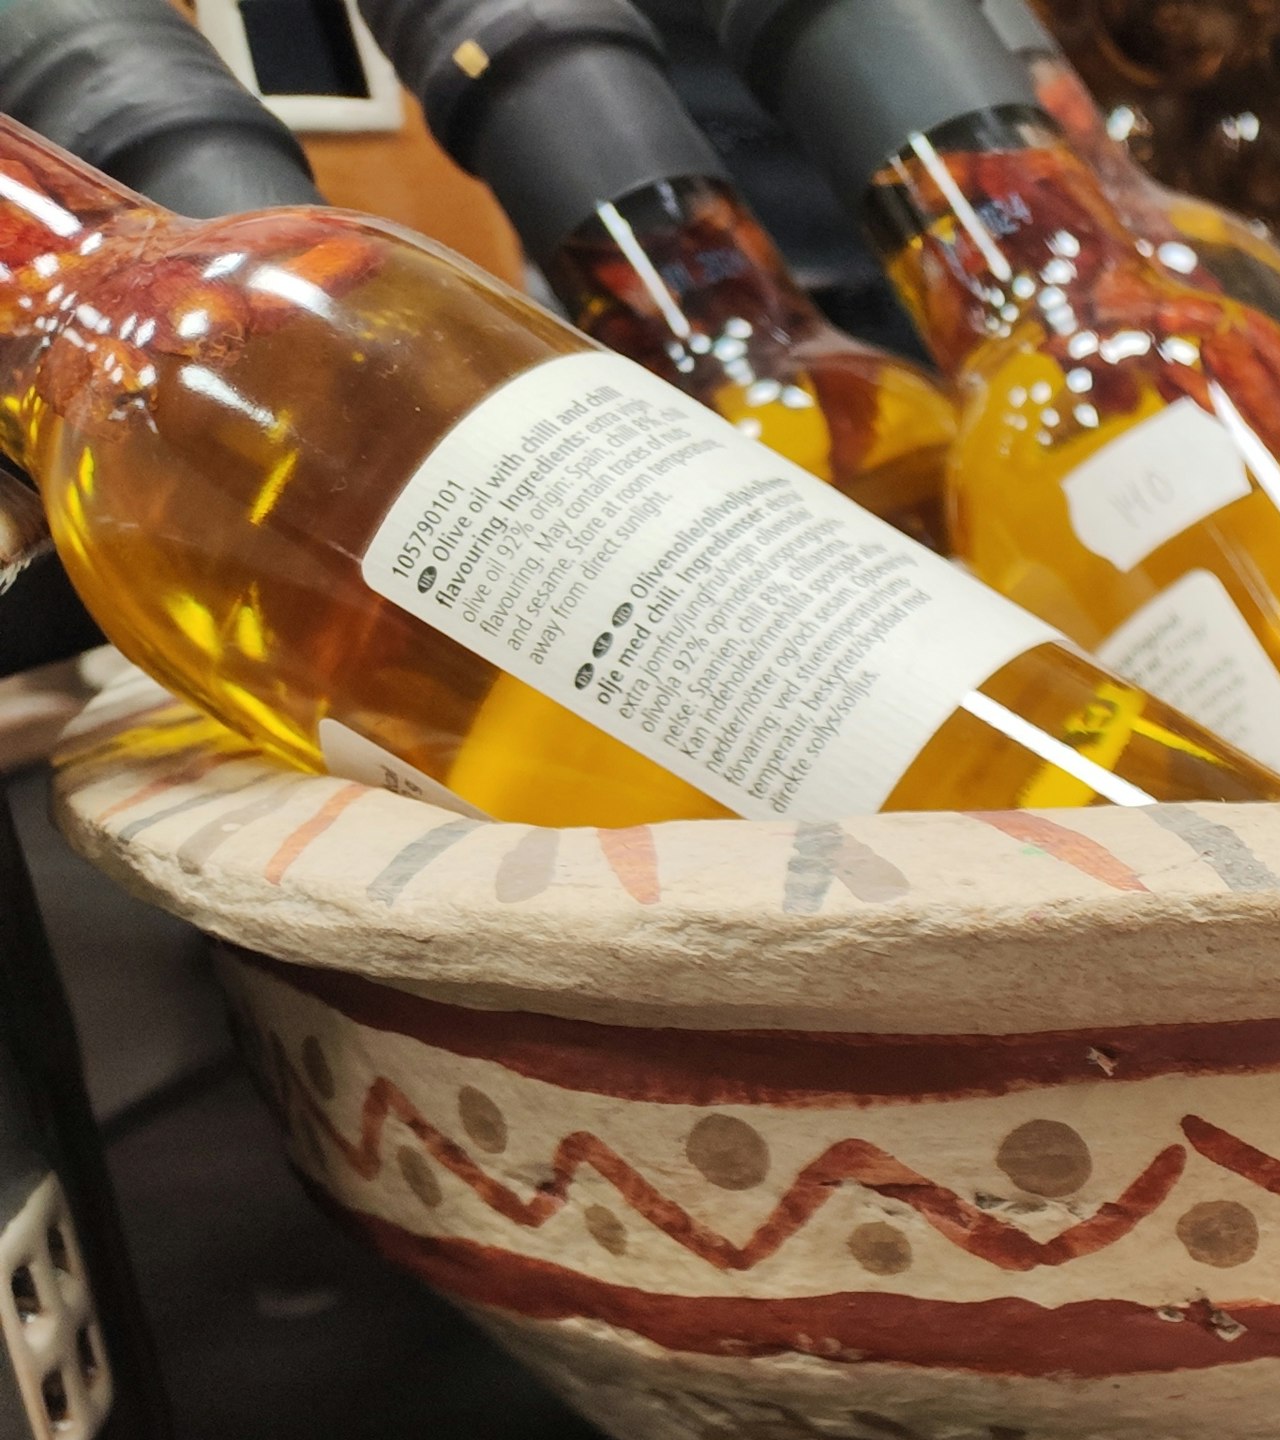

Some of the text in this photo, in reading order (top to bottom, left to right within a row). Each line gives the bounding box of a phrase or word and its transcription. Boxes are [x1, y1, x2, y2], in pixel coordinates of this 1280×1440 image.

[565, 445, 614, 479] Spain,
[606, 422, 640, 447] chilli
[392, 478, 464, 578] 105790101
[418, 385, 622, 592] UK Olive oil with chilli and chilli
[435, 515, 508, 608] flavouring.
[498, 431, 590, 512] Ingredients:
[585, 410, 621, 433] extra
[480, 556, 545, 637] flavouring.
[533, 517, 572, 554] May
[565, 473, 616, 519] contain
[608, 446, 651, 476] traces
[647, 433, 665, 449] of
[530, 476, 573, 520] origin:
[486, 556, 507, 581] oil
[496, 520, 534, 559] 92%
[507, 613, 533, 650] and
[526, 557, 575, 617] sesame.
[565, 515, 606, 555] Store
[601, 500, 622, 519] at
[615, 473, 654, 504] room
[530, 491, 673, 665] away from direct sunlight.
[462, 583, 491, 623] olive
[597, 669, 624, 705] olje
[619, 622, 651, 667] med
[647, 585, 685, 624] chili.
[575, 665, 594, 688] DK
[618, 677, 650, 719] extra
[641, 674, 682, 733] olivolja
[672, 635, 709, 673] 92%
[664, 700, 698, 747] nelse:
[688, 636, 745, 698] Spanien,
[738, 601, 769, 634] chili
[760, 581, 796, 606] 8%,
[705, 666, 779, 774] nødder/nötter
[776, 621, 820, 667] og/och
[816, 585, 860, 622] sesam.
[680, 724, 711, 759] Kan
[723, 710, 781, 786] förvaring:
[773, 678, 801, 709] ved
[747, 712, 814, 798] temperatur,
[770, 670, 880, 813] direkte sollys/solljus.
